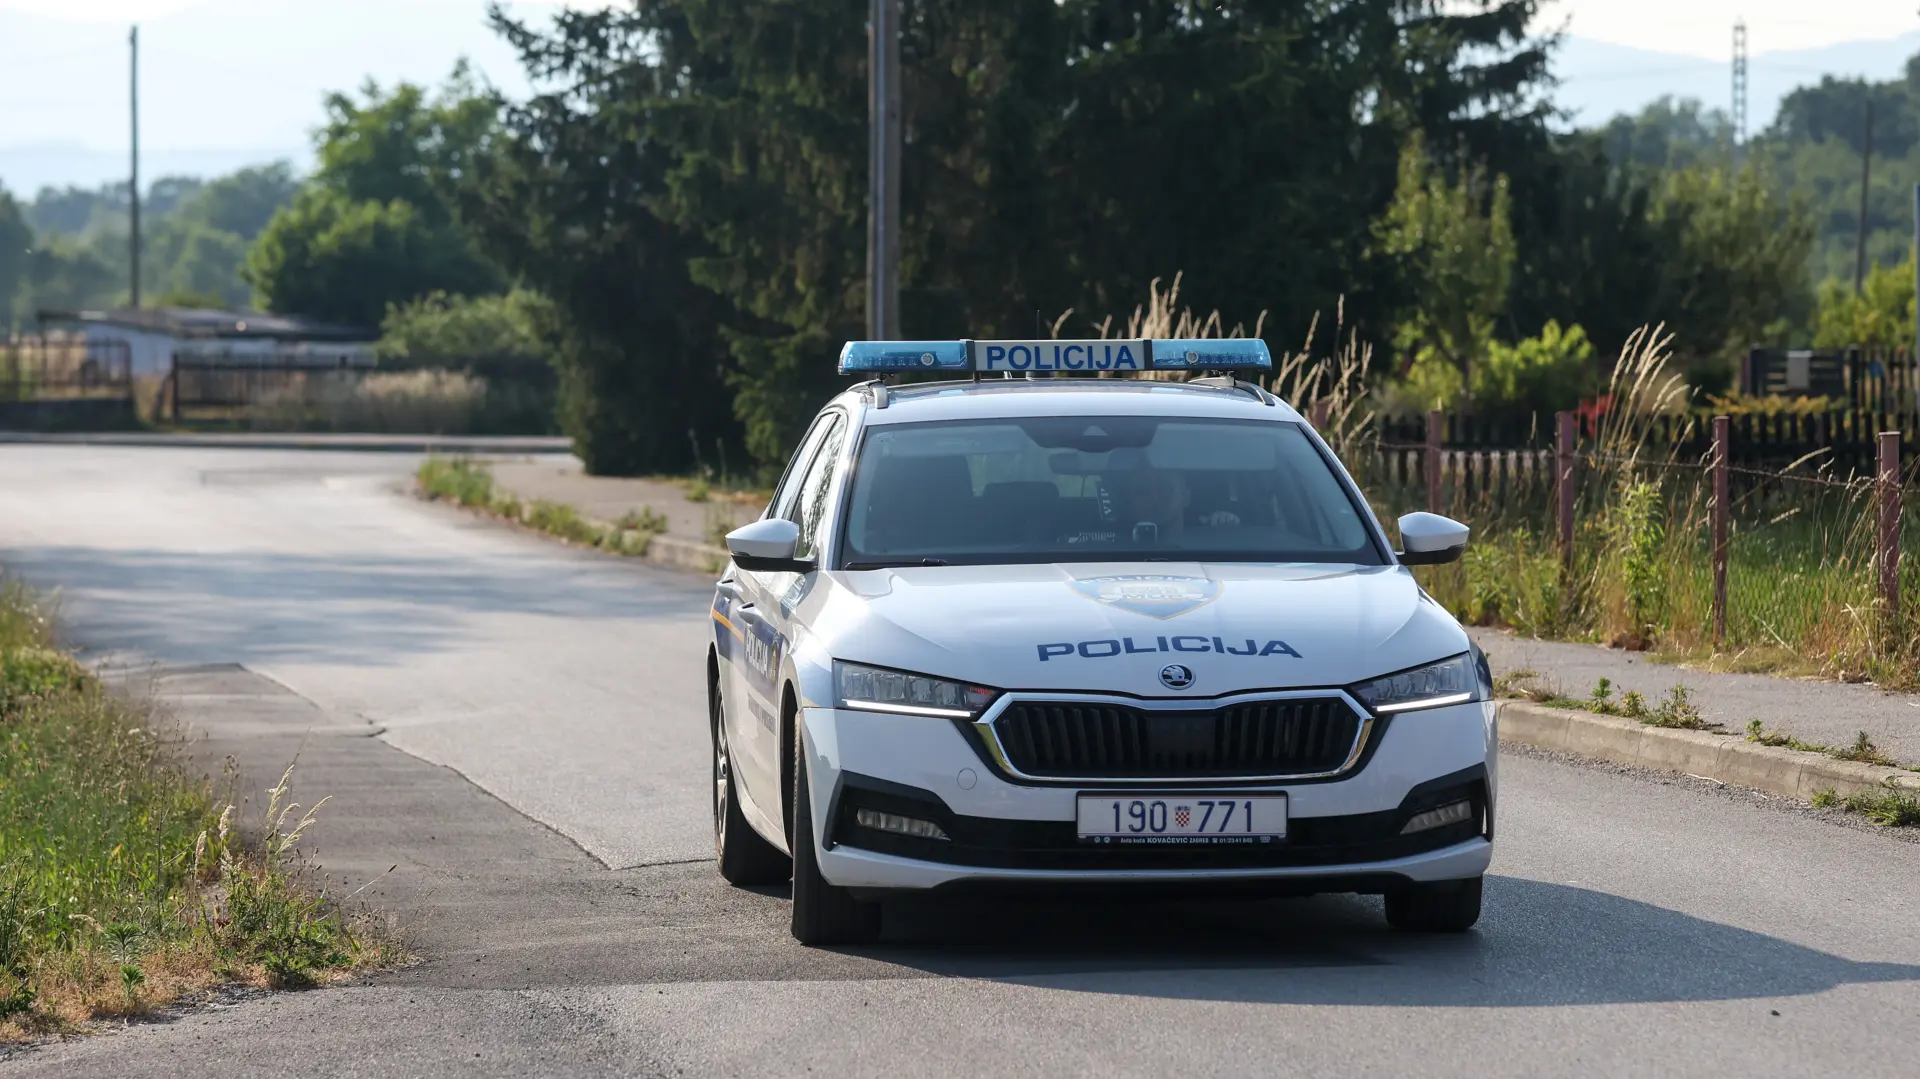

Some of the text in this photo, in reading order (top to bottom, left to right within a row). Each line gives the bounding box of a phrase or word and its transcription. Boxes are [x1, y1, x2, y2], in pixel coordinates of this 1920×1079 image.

[986, 345, 1137, 370] POLICIJA
[1036, 636, 1303, 661] POLICIJA
[1112, 801, 1252, 833] 190 771
[1147, 836, 1188, 844] KOVAČEVIĆ
